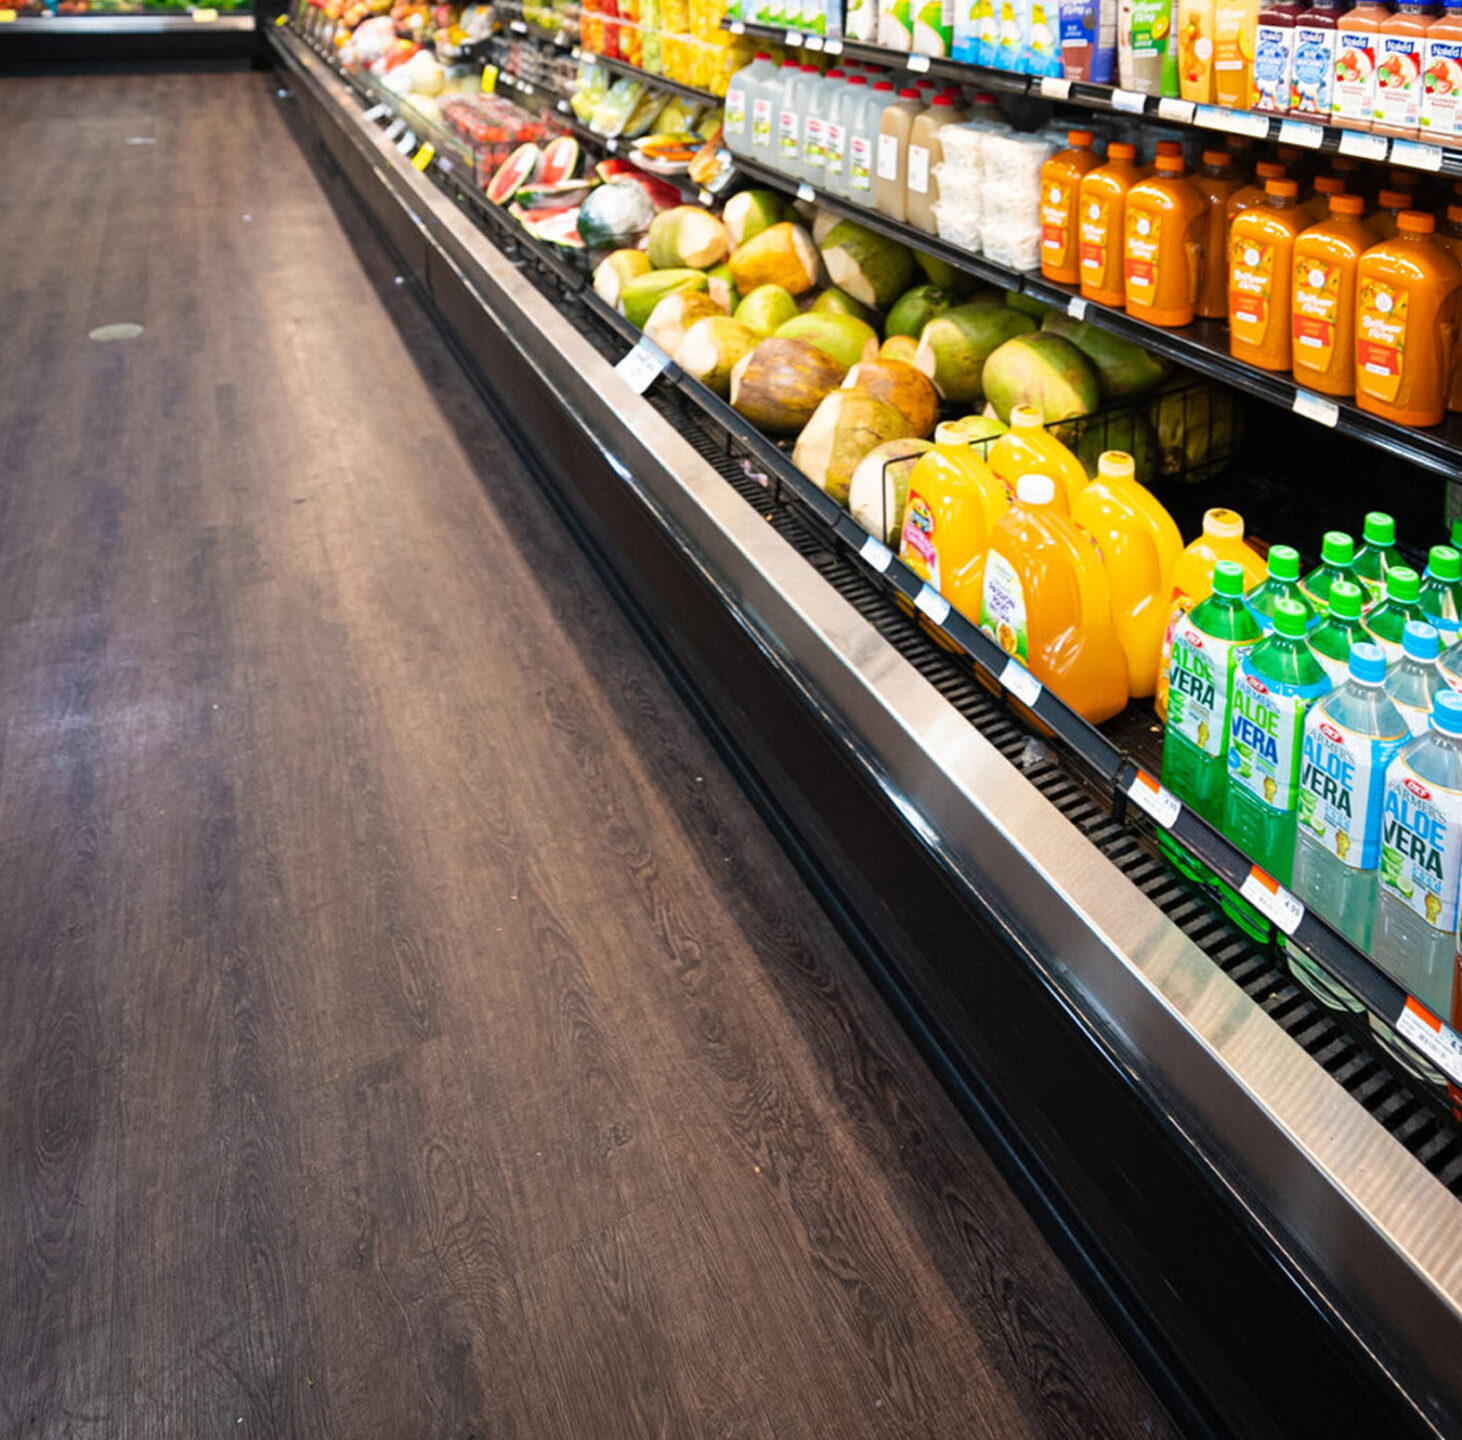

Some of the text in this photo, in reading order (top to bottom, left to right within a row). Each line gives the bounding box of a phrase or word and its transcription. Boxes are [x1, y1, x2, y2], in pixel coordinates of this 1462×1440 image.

[1170, 666, 1214, 710] VERA
[1172, 641, 1215, 687] ALOE
[1232, 689, 1280, 738] ALOE
[1232, 715, 1278, 764] VERA
[1303, 734, 1355, 792] ALOE
[1302, 763, 1352, 819] VERA
[1385, 789, 1447, 853] ALOE
[1384, 820, 1443, 880] VERA
